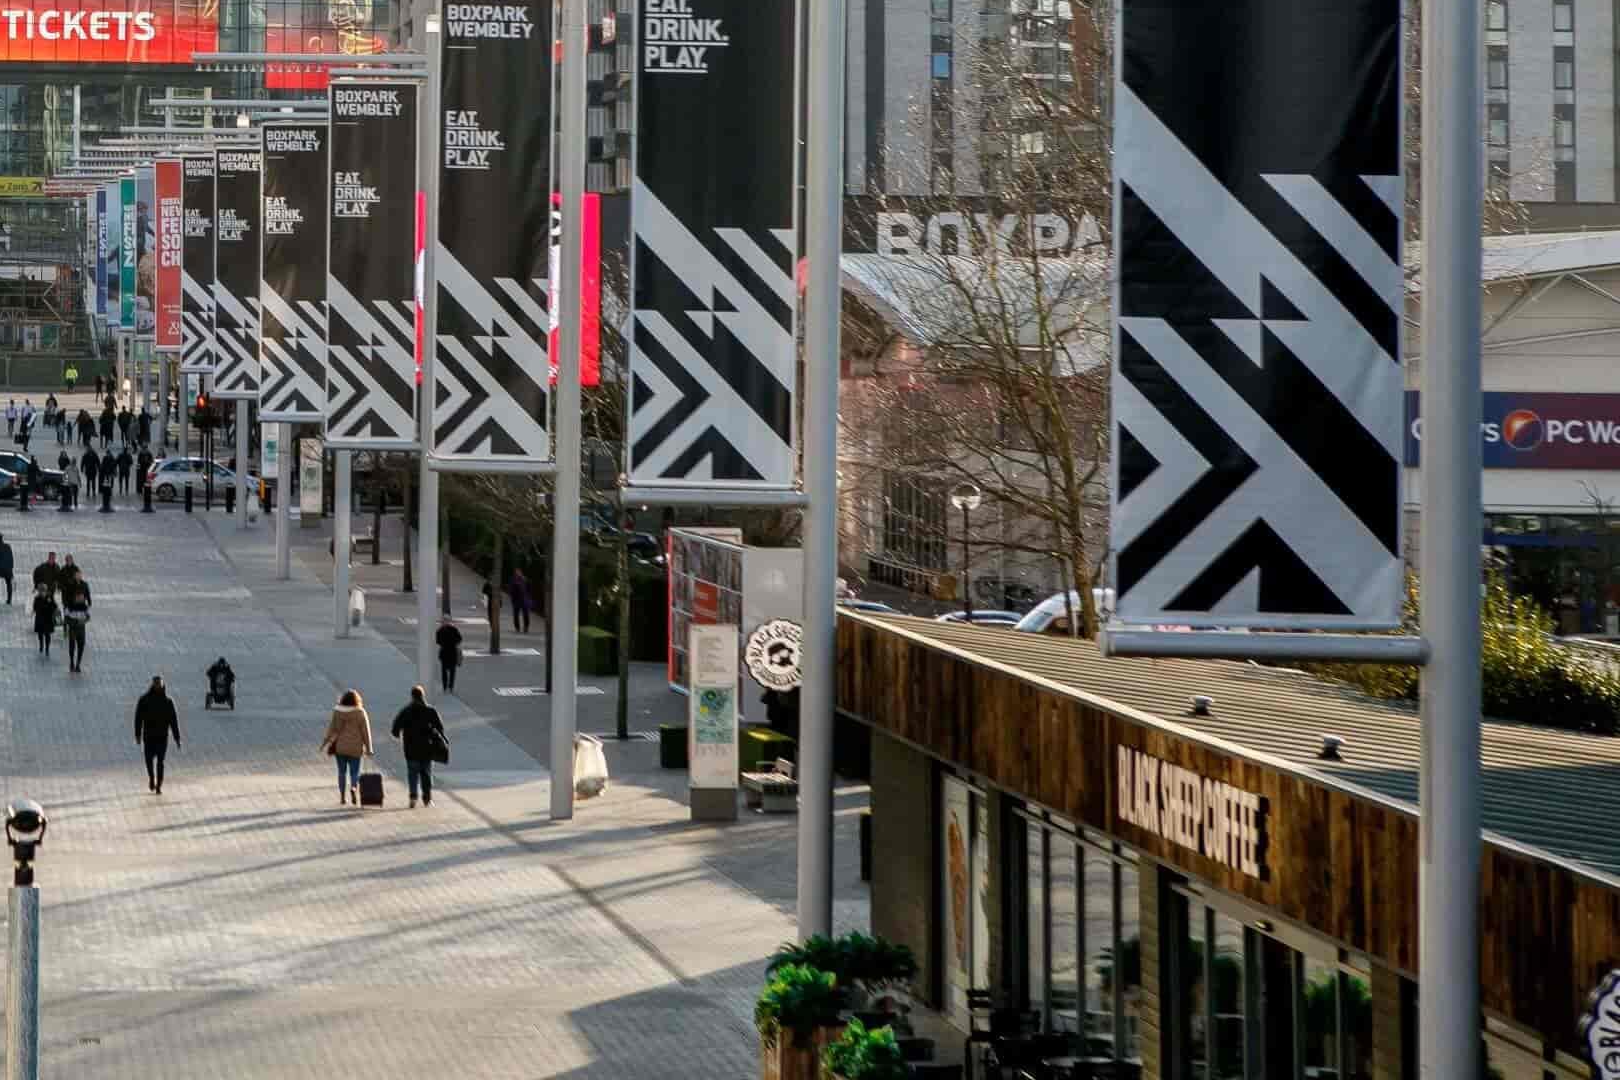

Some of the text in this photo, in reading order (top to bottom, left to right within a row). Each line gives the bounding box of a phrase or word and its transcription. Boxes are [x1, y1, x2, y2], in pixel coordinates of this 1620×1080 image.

[447, 5, 528, 22] BOXPARK
[2, 10, 156, 41] TICKETS
[448, 22, 533, 39] WEMBLEY
[644, 18, 729, 41] DRINK.
[644, 46, 708, 69] PLAY.
[335, 90, 398, 103] BOXPARK
[335, 104, 402, 116] WEMBLEY
[446, 111, 479, 127] EAT.
[266, 129, 317, 141] BOXPARK
[445, 130, 505, 147] DRINK.
[266, 141, 321, 152] WEMBLEY
[445, 150, 490, 166] PLAY.
[219, 162, 261, 171] WEMBLE
[335, 172, 361, 185] EAT.
[335, 187, 380, 200] DRINK.
[265, 197, 287, 208] EAT.
[335, 202, 369, 215] PLAY.
[265, 209, 303, 220] DRINK.
[161, 217, 180, 233] FE
[265, 222, 294, 232] PLAY.
[877, 212, 1104, 257] BOXPA
[161, 251, 180, 267] CH
[1547, 419, 1584, 444] PC
[1118, 744, 1259, 878] BLACK SHEEP COFFEE
